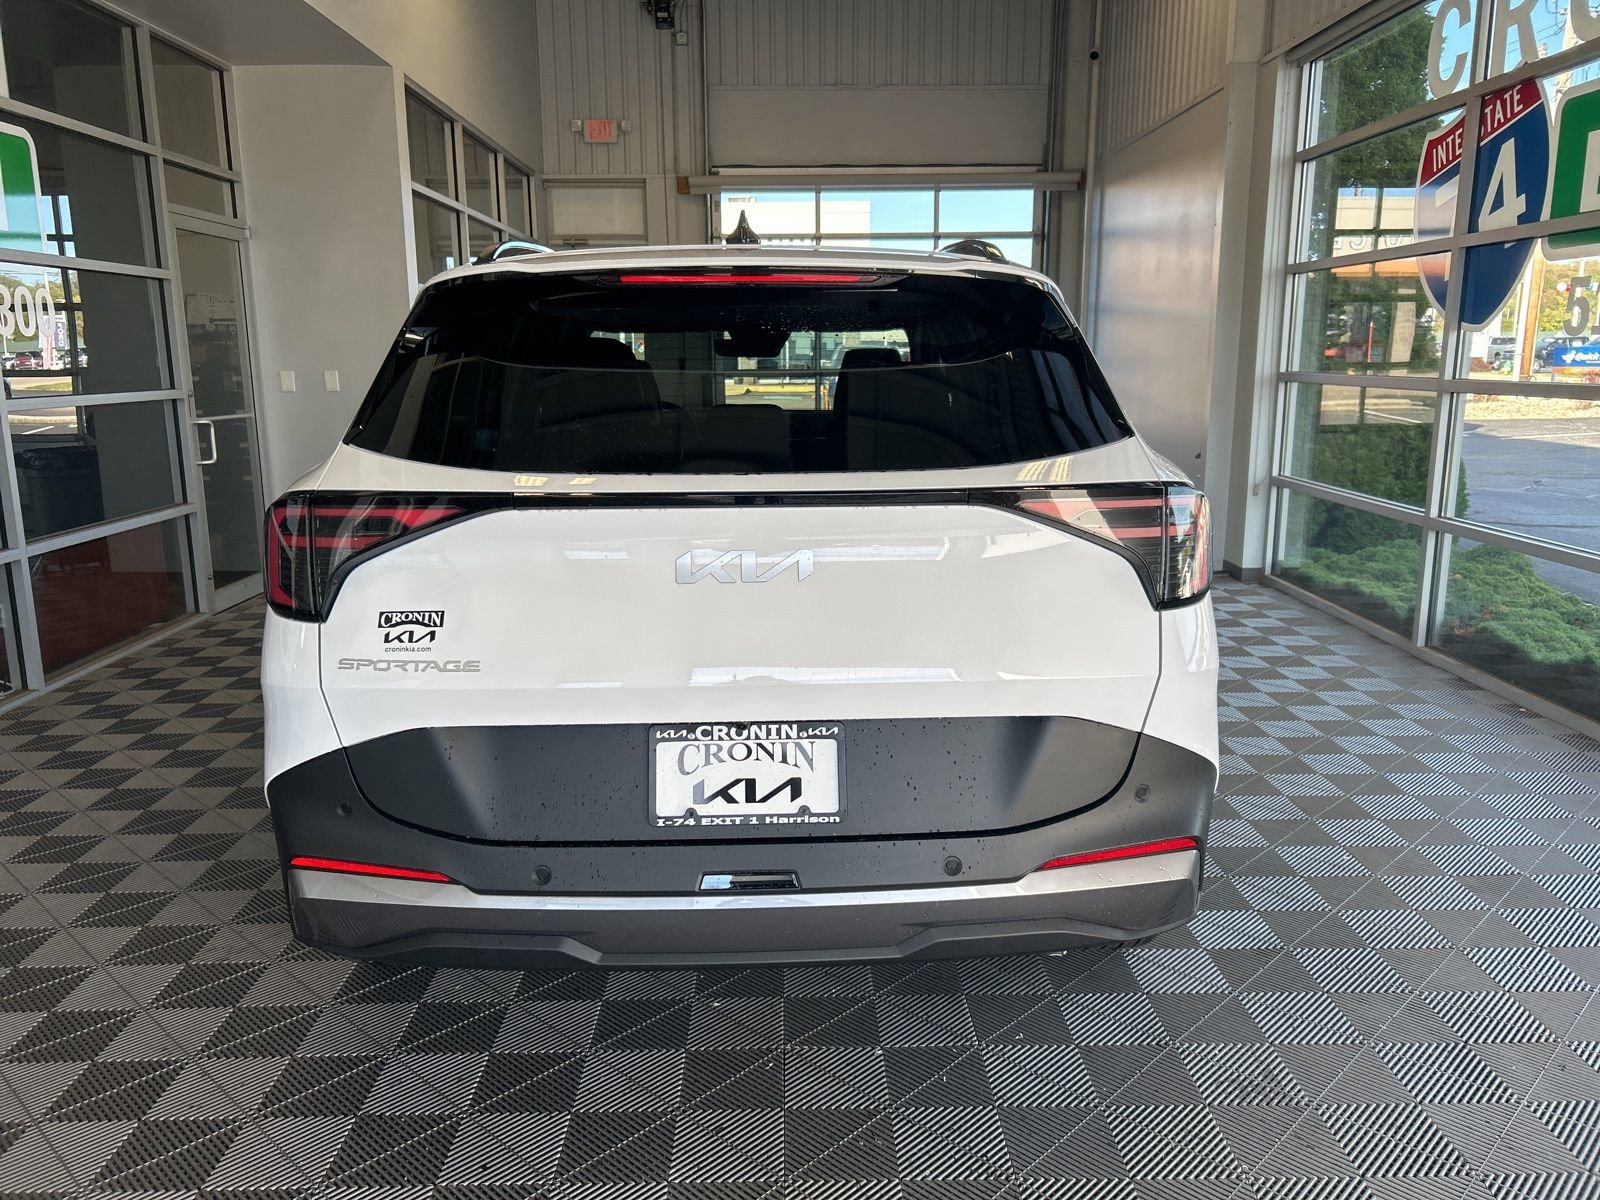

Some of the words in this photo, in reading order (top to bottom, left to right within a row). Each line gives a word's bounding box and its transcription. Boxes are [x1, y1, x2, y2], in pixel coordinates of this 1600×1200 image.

[1427, 0, 1600, 100] CR
[1432, 83, 1525, 173] INTETATE
[675, 549, 814, 584] KIA
[380, 611, 442, 628] CRONIN
[384, 630, 436, 644] KIA
[384, 645, 432, 653] croninkia.com
[337, 657, 481, 673] SPORTAGE
[695, 723, 798, 741] CRONIN
[677, 740, 816, 776] CRONIN
[692, 776, 802, 804] KIA
[656, 817, 697, 827] I-74
[701, 816, 744, 826] EXIT
[748, 816, 760, 825] 1
[765, 814, 840, 824] Harrison
